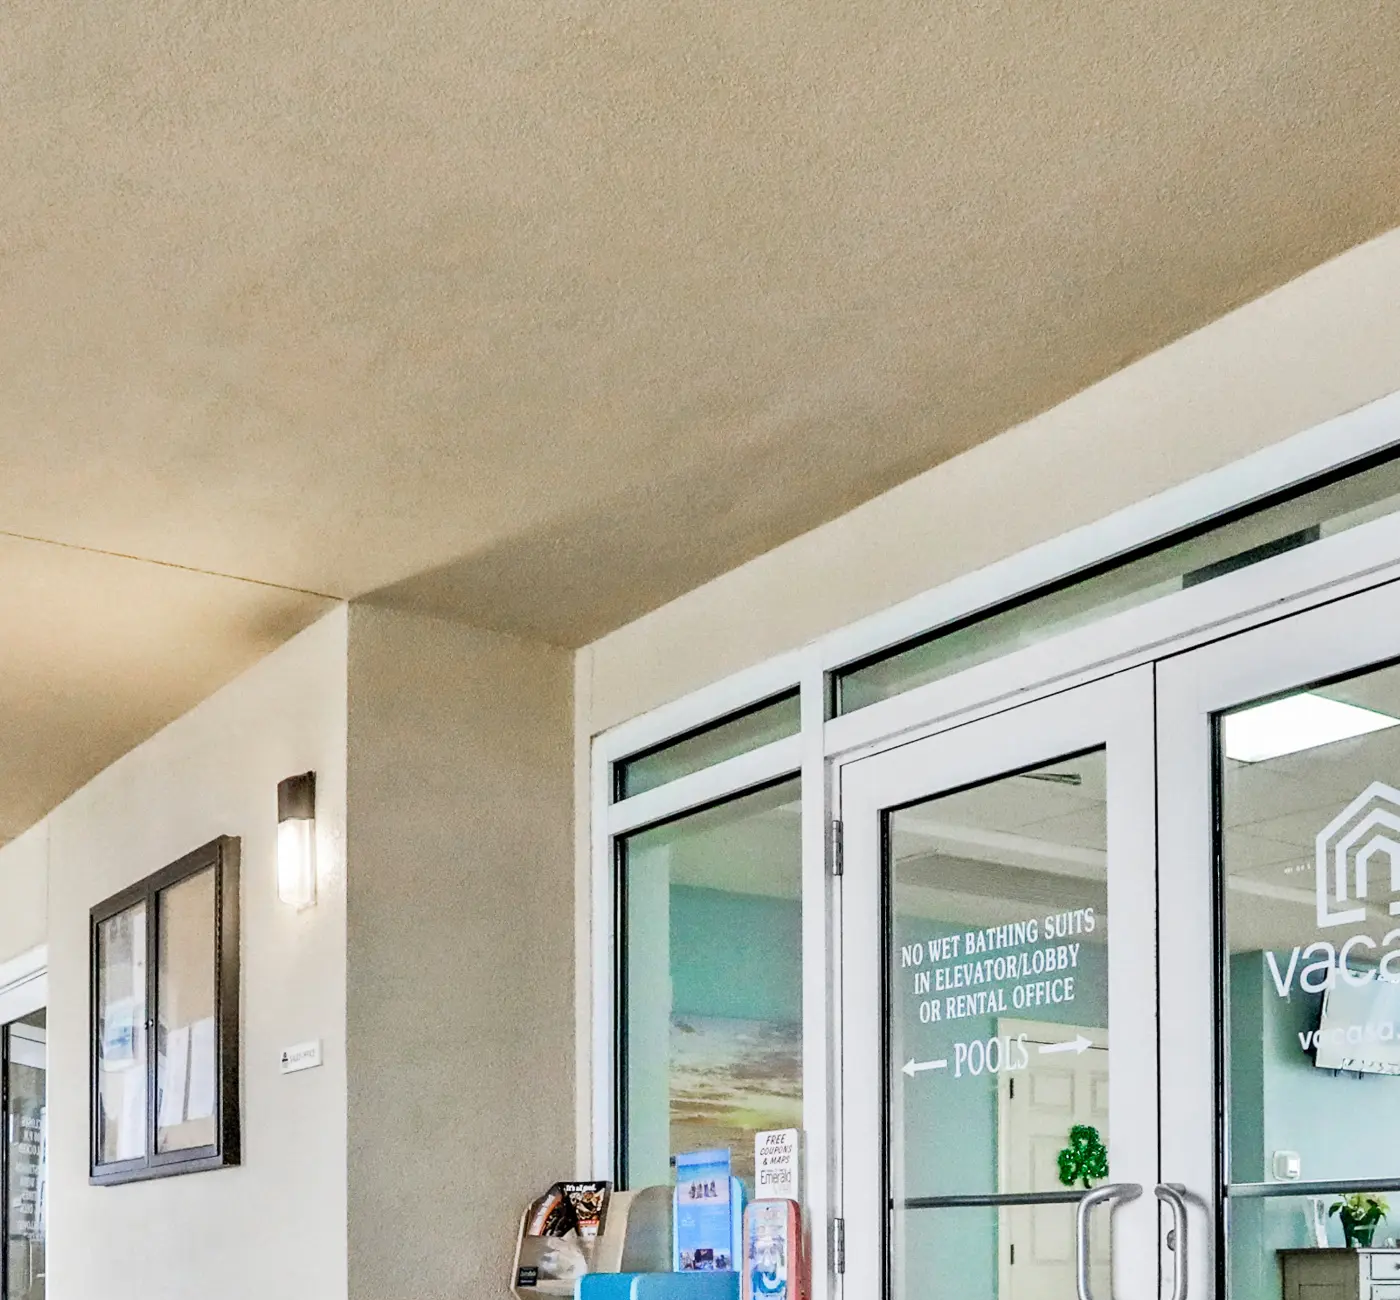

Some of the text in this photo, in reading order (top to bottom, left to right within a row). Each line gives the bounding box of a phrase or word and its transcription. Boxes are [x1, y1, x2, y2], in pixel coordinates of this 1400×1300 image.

[901, 907, 1095, 968] NO WET BATHING SUITS
[914, 942, 1080, 995] IN ELEVATOR/LOBBY
[919, 976, 1075, 1024] OR RENTAL OFFICE
[953, 1032, 1029, 1078] POOLS
[760, 1145, 793, 1156] COUPONS
[765, 1133, 787, 1145] FREE
[770, 1155, 790, 1165] MAPS
[761, 1168, 792, 1184] Emerald
